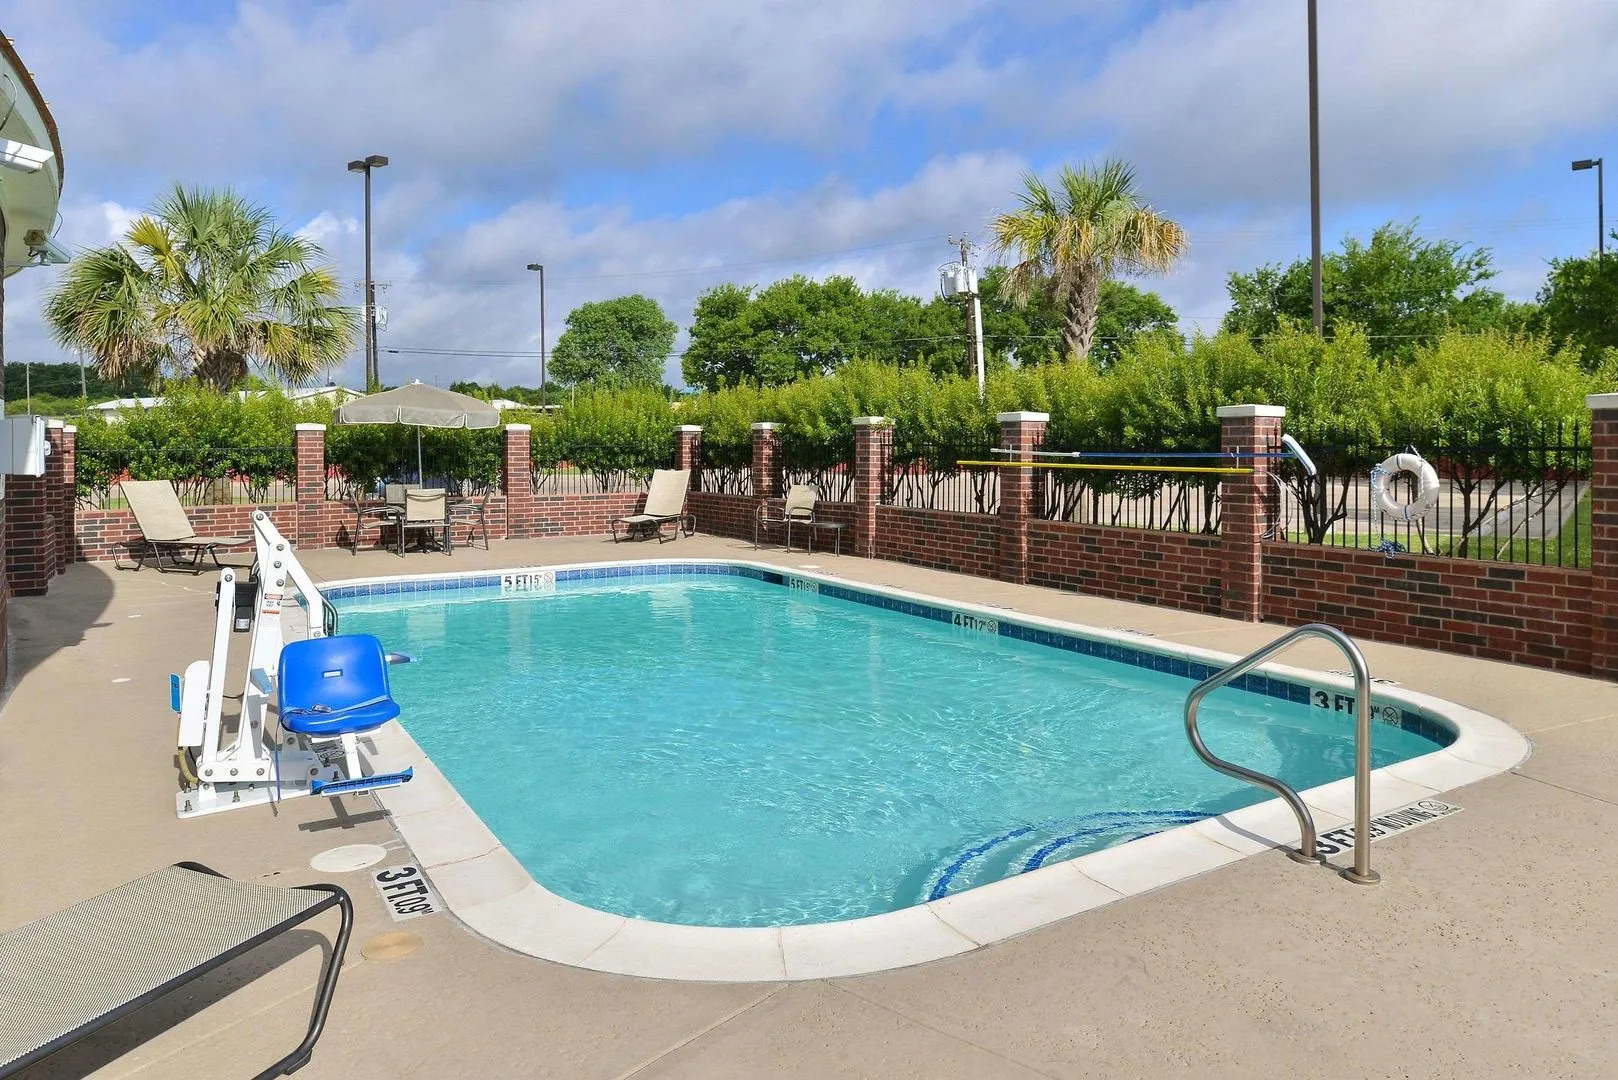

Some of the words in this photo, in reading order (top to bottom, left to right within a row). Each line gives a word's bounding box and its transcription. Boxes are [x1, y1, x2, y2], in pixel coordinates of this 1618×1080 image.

[1314, 691, 1330, 709] 3
[1334, 694, 1356, 715] FT
[376, 866, 418, 883] 3
